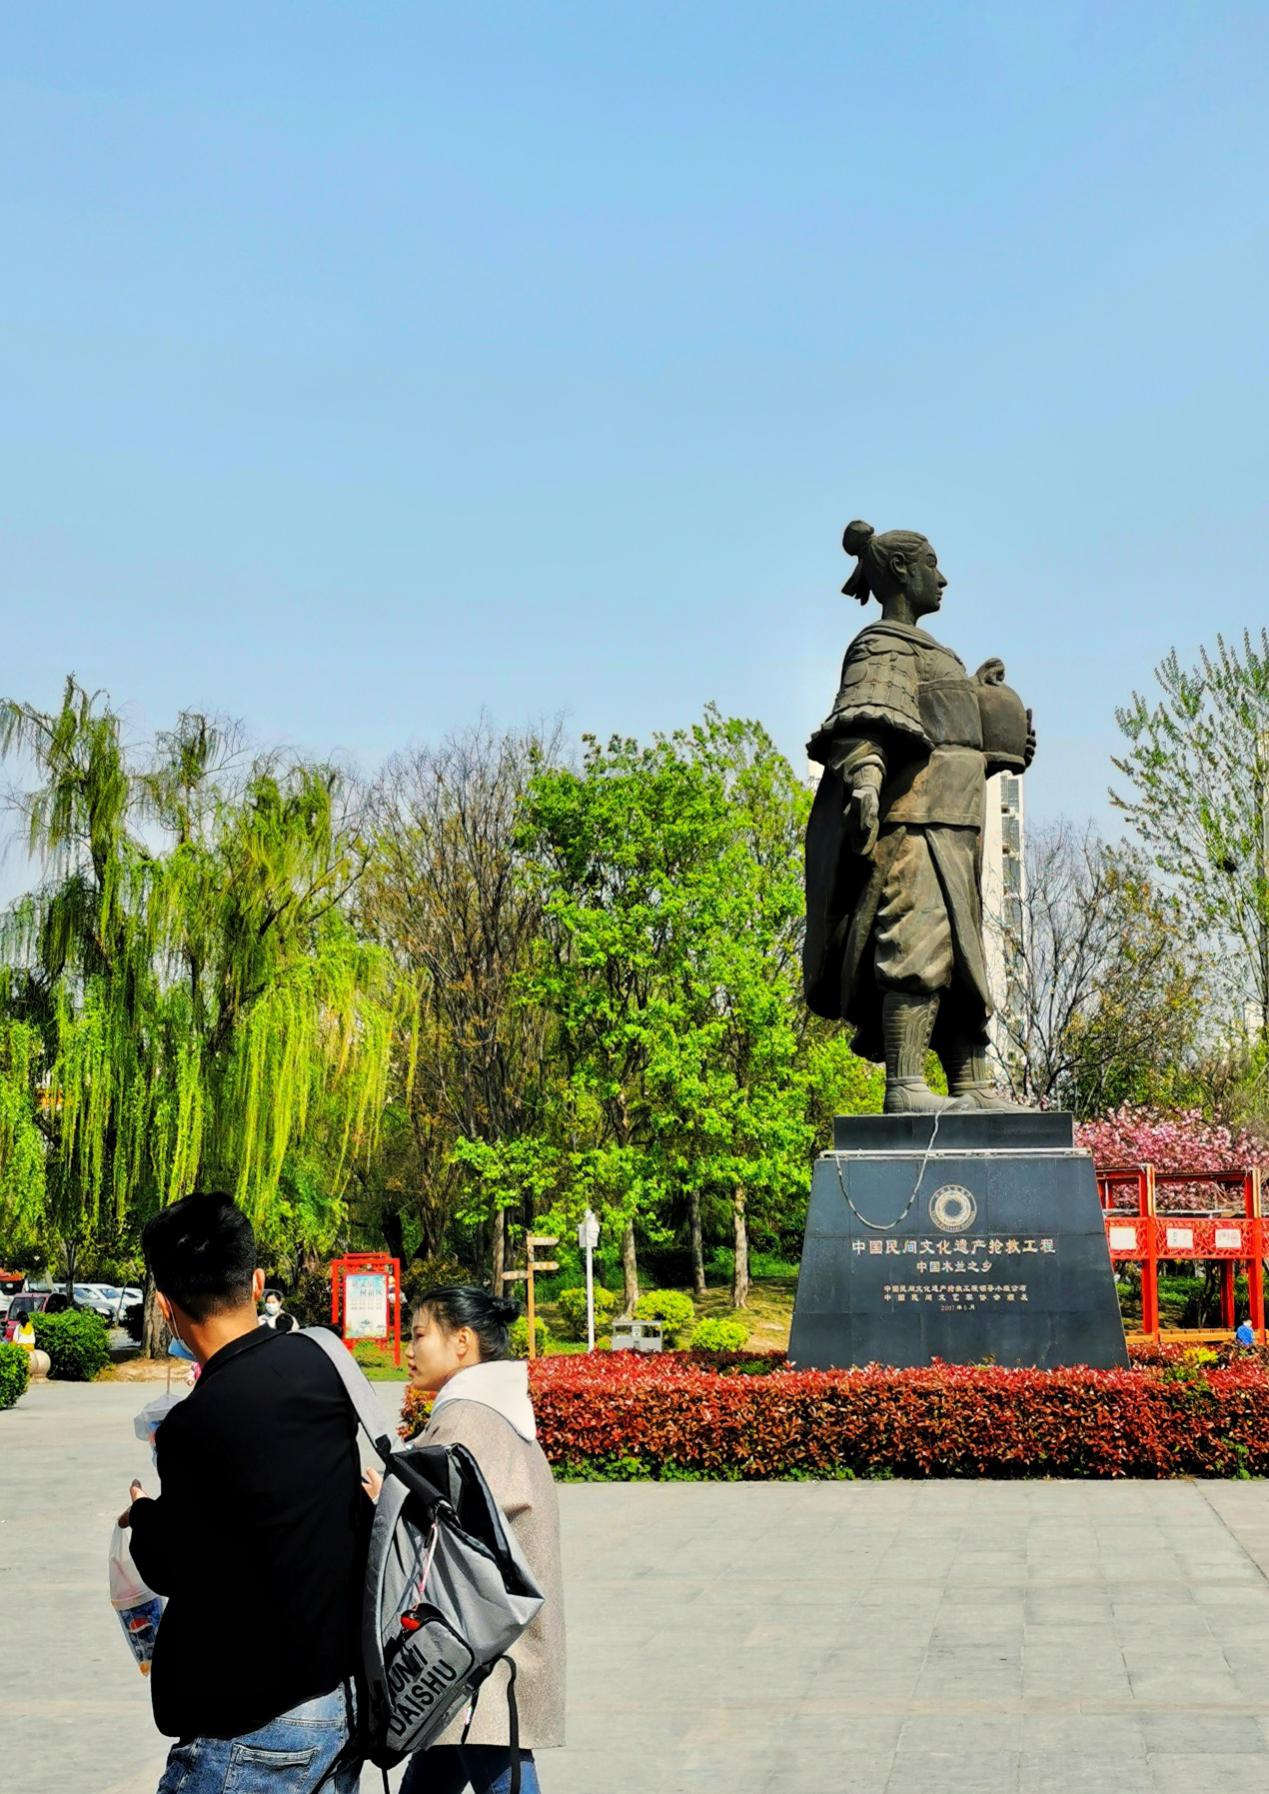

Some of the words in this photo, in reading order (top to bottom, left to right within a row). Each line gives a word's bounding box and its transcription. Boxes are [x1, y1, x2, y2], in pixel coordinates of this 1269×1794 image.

[852, 1238, 1056, 1255] 中国民间文化遗产抢救工程
[916, 1260, 993, 1274] 中国木兰之乡
[389, 1659, 457, 1737] DAISHU
